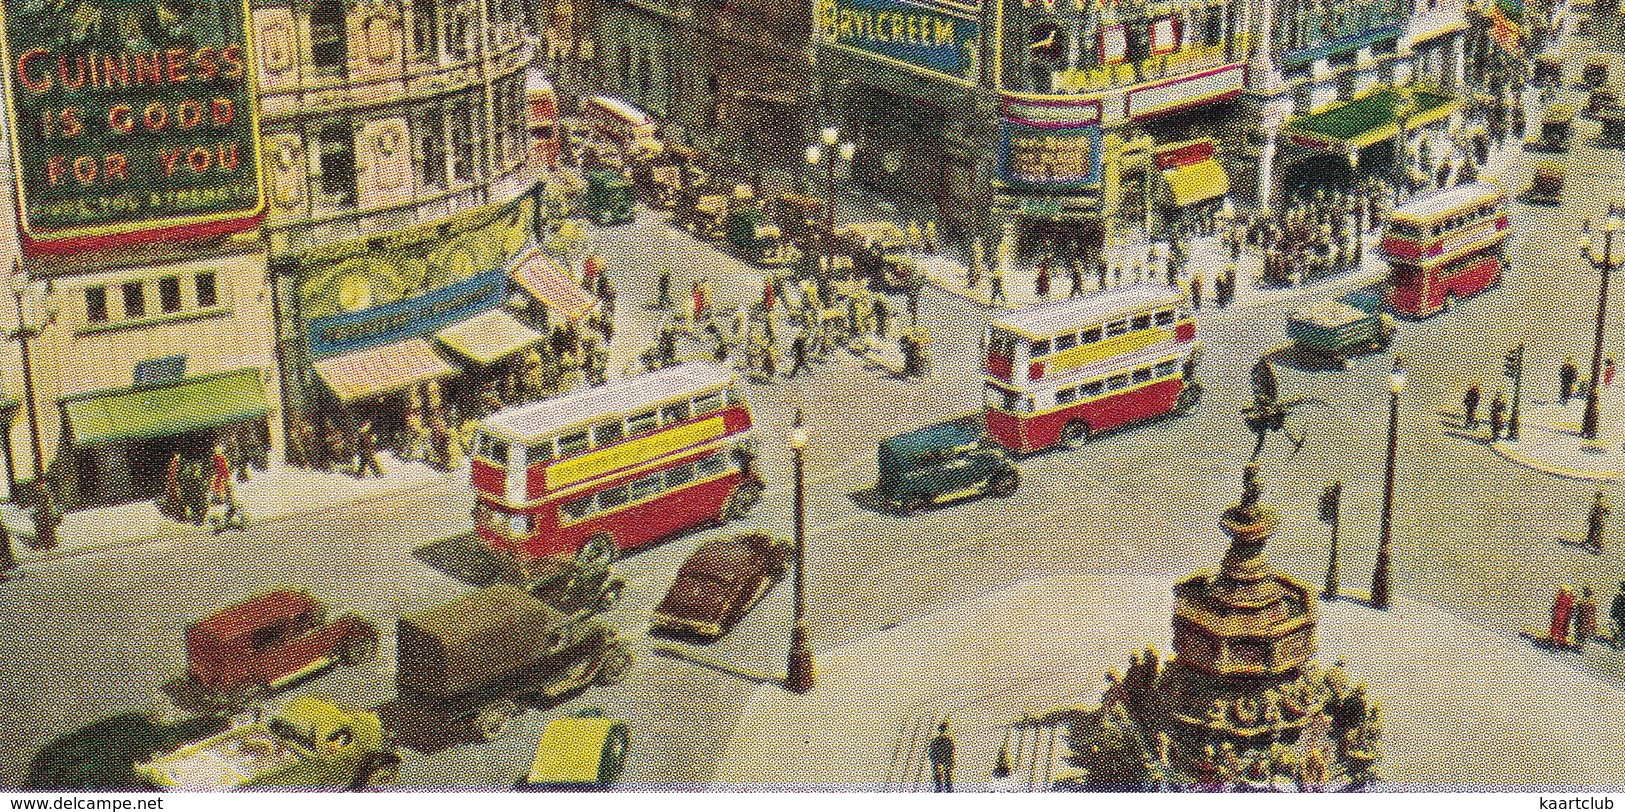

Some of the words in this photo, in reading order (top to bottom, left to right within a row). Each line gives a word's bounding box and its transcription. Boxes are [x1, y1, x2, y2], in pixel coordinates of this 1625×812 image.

[818, 0, 955, 47] BRYLCREEM
[18, 43, 244, 93] GUINNESS
[44, 106, 82, 137] IS
[108, 96, 234, 132] GOOD
[49, 152, 128, 186] FOR
[158, 144, 238, 177] YOU
